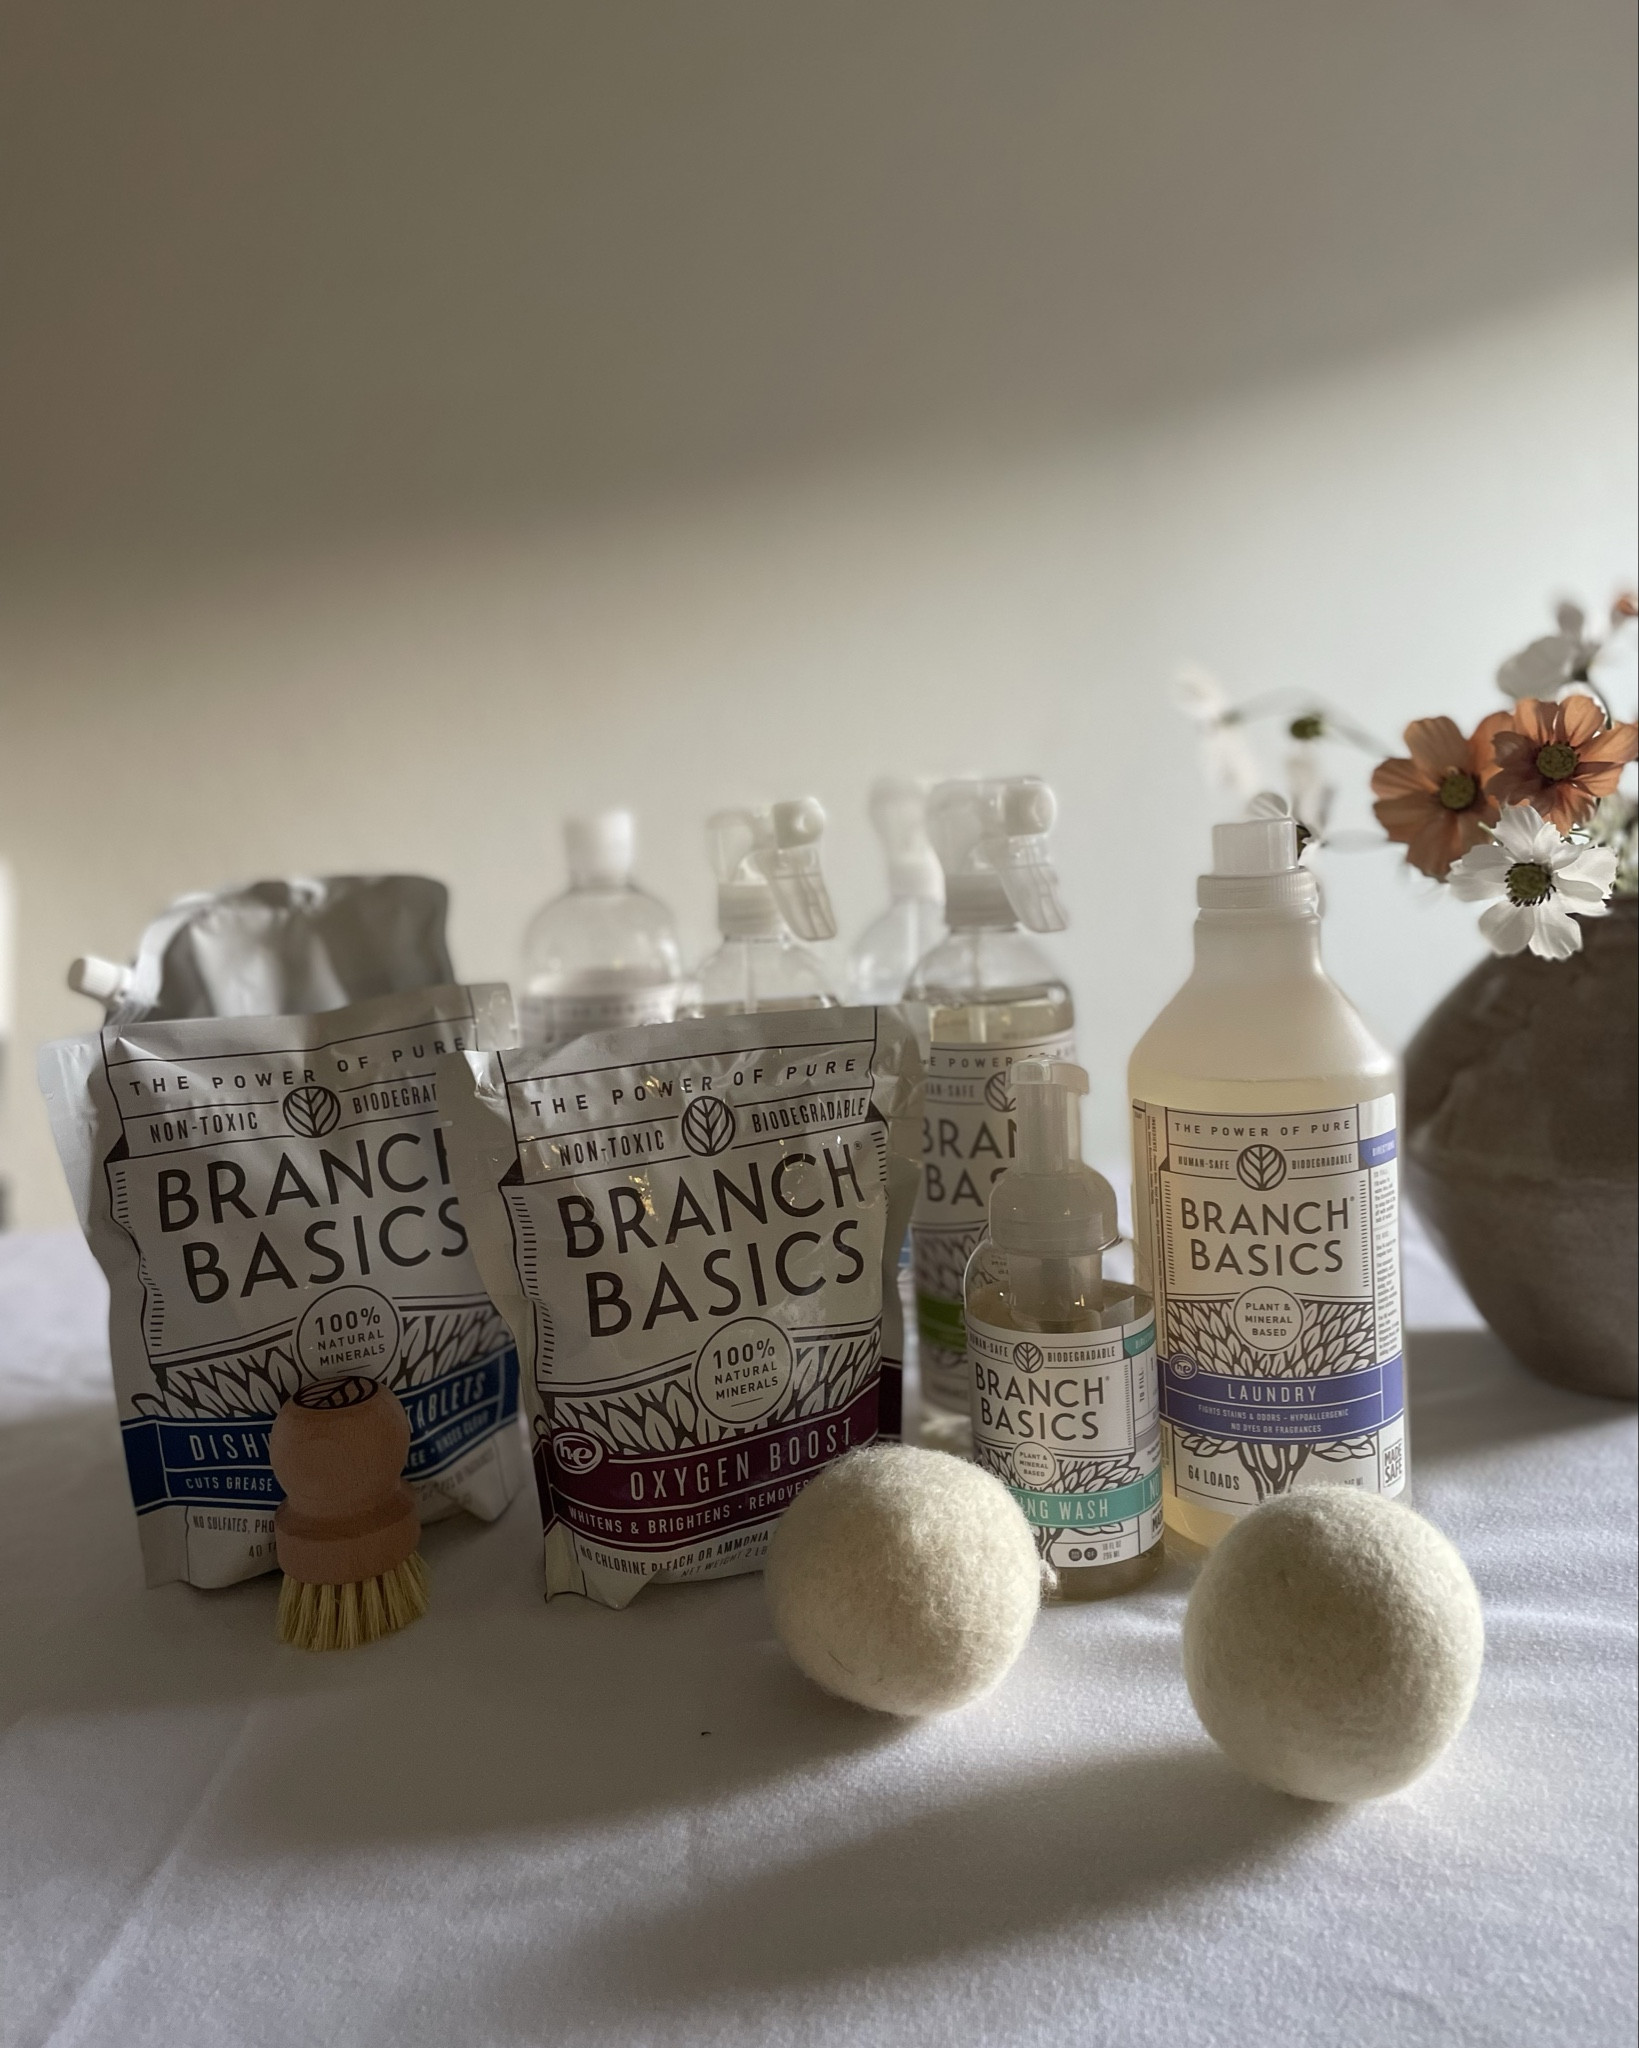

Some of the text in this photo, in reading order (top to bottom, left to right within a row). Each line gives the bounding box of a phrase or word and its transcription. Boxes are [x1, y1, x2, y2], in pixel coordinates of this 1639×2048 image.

[130, 1036, 466, 1096] THE POWER OF PURE
[948, 1056, 1014, 1069] POWER
[530, 1057, 858, 1118] THE POWER OF PURE
[149, 1111, 258, 1144] NON-TOXIC
[751, 1097, 866, 1134] BIODEGRADABLE
[1174, 1120, 1351, 1137] THE POWER OF PURE
[559, 1128, 666, 1167] NON-TOXIC
[1178, 1155, 1230, 1170] HUMAN-SAFE
[1291, 1153, 1353, 1170] BIODEGRADABLE
[181, 1196, 470, 1305] BASICS
[1190, 1238, 1344, 1277] BASICS
[584, 1219, 864, 1338] BASICS
[1245, 1302, 1291, 1311] PLANT &
[314, 1305, 381, 1336] 100%
[1244, 1314, 1294, 1324] MINERAL
[317, 1328, 385, 1351] NATURAL
[1251, 1327, 1287, 1337] BASED
[319, 1343, 386, 1367] MINERALS
[712, 1337, 776, 1370] 100%
[1047, 1345, 1116, 1363] BIODEGRADABLE
[714, 1360, 778, 1386] NATURAL
[715, 1375, 779, 1401] MINERALS
[1227, 1383, 1317, 1403] LAUNDRY
[980, 1396, 1100, 1441] BASICS
[1198, 1404, 1222, 1416] FIGHTS
[1222, 1409, 1247, 1420] STAINS
[1249, 1413, 1254, 1421] &
[1256, 1413, 1281, 1422] ODORS
[1289, 1408, 1350, 1421] HYPOALLERGENIC
[1230, 1422, 1322, 1434] NO DYES OR FRAGRANCES
[629, 1417, 851, 1502] OXYGEN BOOST
[1019, 1451, 1040, 1460] PLANT
[1019, 1460, 1049, 1470] MINERAL
[185, 1477, 219, 1490] CUTS
[226, 1476, 273, 1492] GREASE
[1023, 1468, 1046, 1477] BASED
[1188, 1464, 1240, 1490] 64 LOADS
[567, 1505, 623, 1534] WHITENS
[630, 1521, 640, 1535] &
[648, 1504, 731, 1535] BRIGHTENS
[1059, 1497, 1109, 1521] WASH
[192, 1515, 205, 1529] NO
[248, 1544, 263, 1558] 40
[579, 1544, 593, 1562] NO
[595, 1552, 648, 1576] CHLORINE
[698, 1547, 713, 1562] OR
[716, 1530, 769, 1556] AMMONIA
[681, 1564, 701, 1578] NET
[704, 1550, 742, 1571] WEIGHT
[744, 1548, 754, 1558] 2
